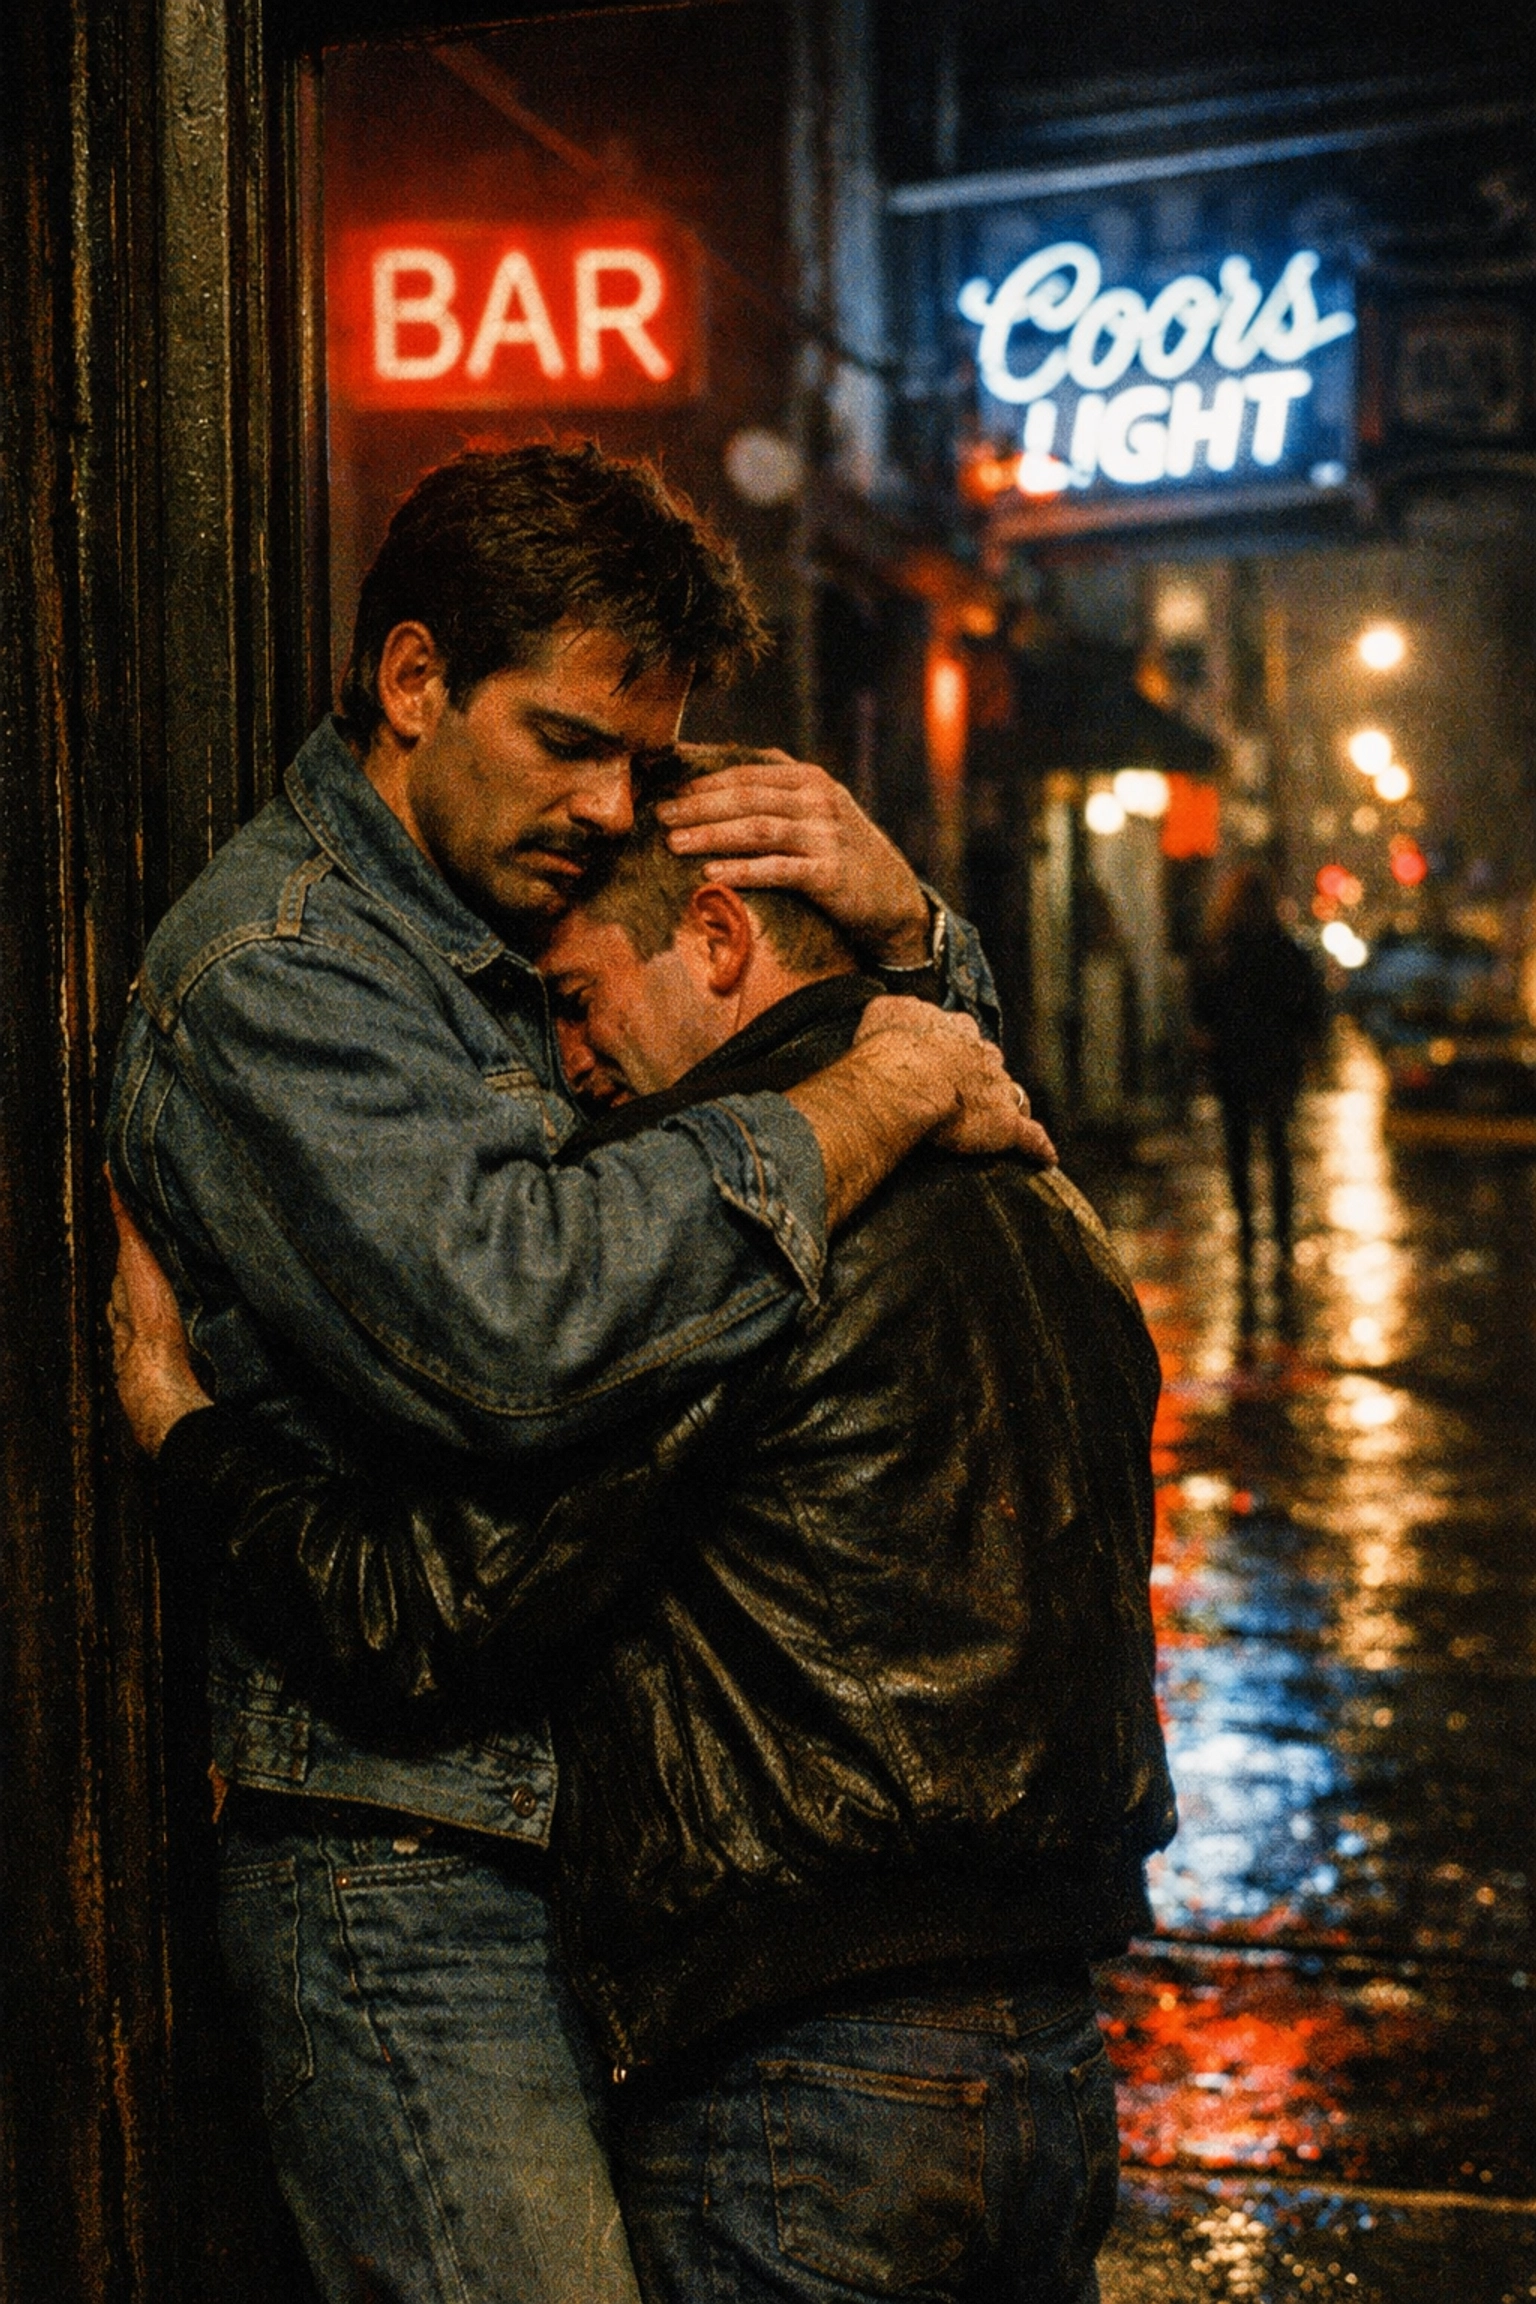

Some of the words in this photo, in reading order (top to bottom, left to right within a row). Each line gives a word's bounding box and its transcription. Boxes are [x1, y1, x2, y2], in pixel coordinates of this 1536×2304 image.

[372, 247, 674, 381] BAR
[957, 241, 1356, 404] Coors
[1018, 369, 1312, 494] LIGHT
